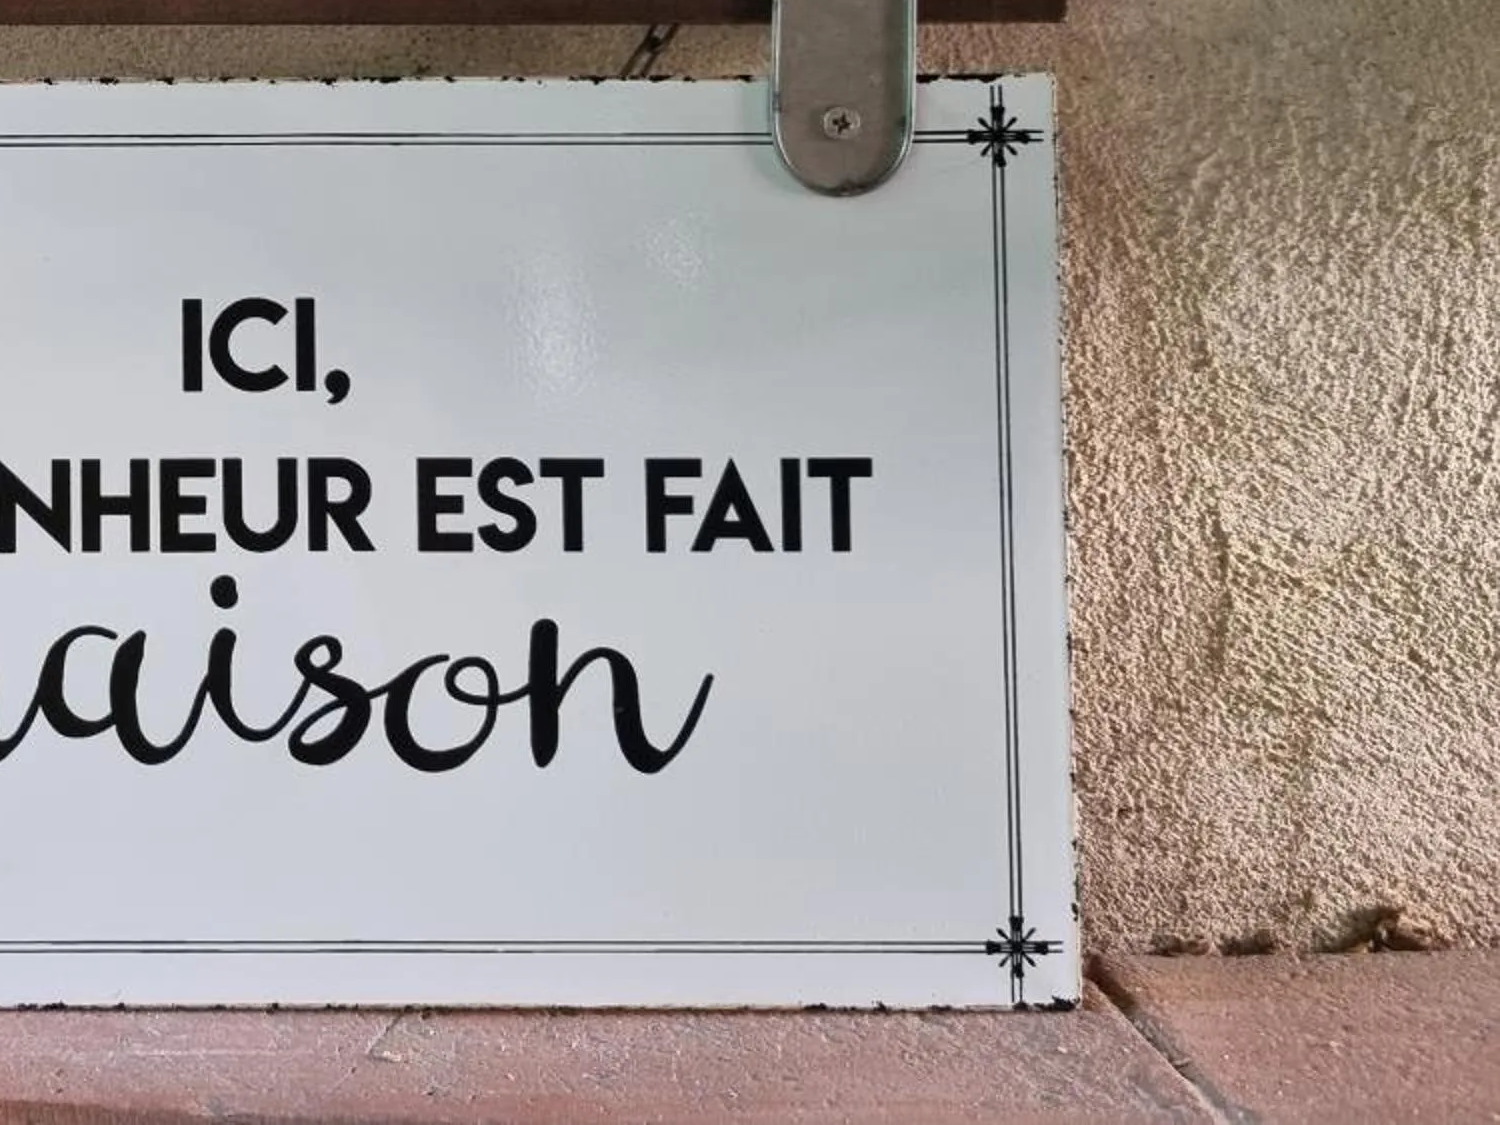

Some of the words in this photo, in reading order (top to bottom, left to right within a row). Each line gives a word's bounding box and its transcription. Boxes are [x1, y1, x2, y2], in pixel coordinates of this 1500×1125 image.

[181, 296, 352, 405] ICI,
[416, 456, 605, 553] EST
[644, 457, 873, 554] FAIT
